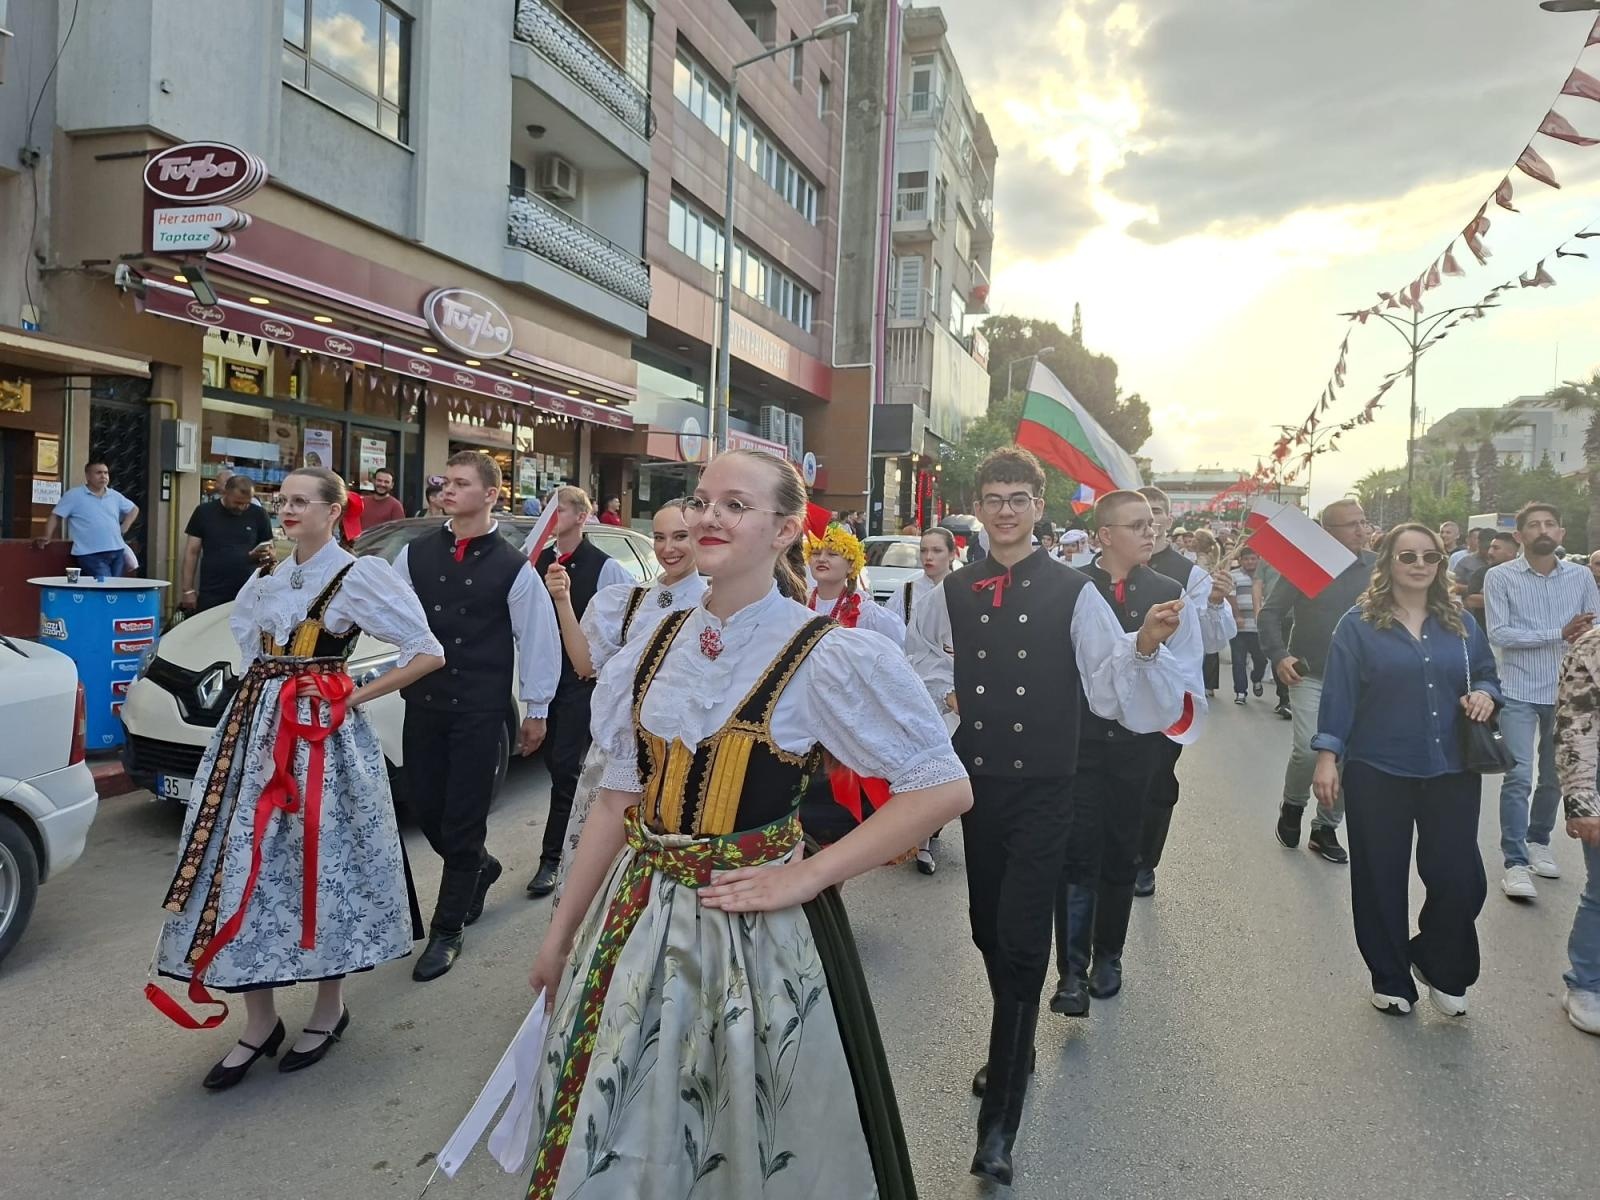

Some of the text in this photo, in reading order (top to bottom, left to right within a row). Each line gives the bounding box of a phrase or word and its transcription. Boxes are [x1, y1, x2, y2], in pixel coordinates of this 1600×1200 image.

[159, 212, 223, 225] Her zaman
[160, 232, 210, 244] Taptaze
[165, 778, 179, 797] 35
